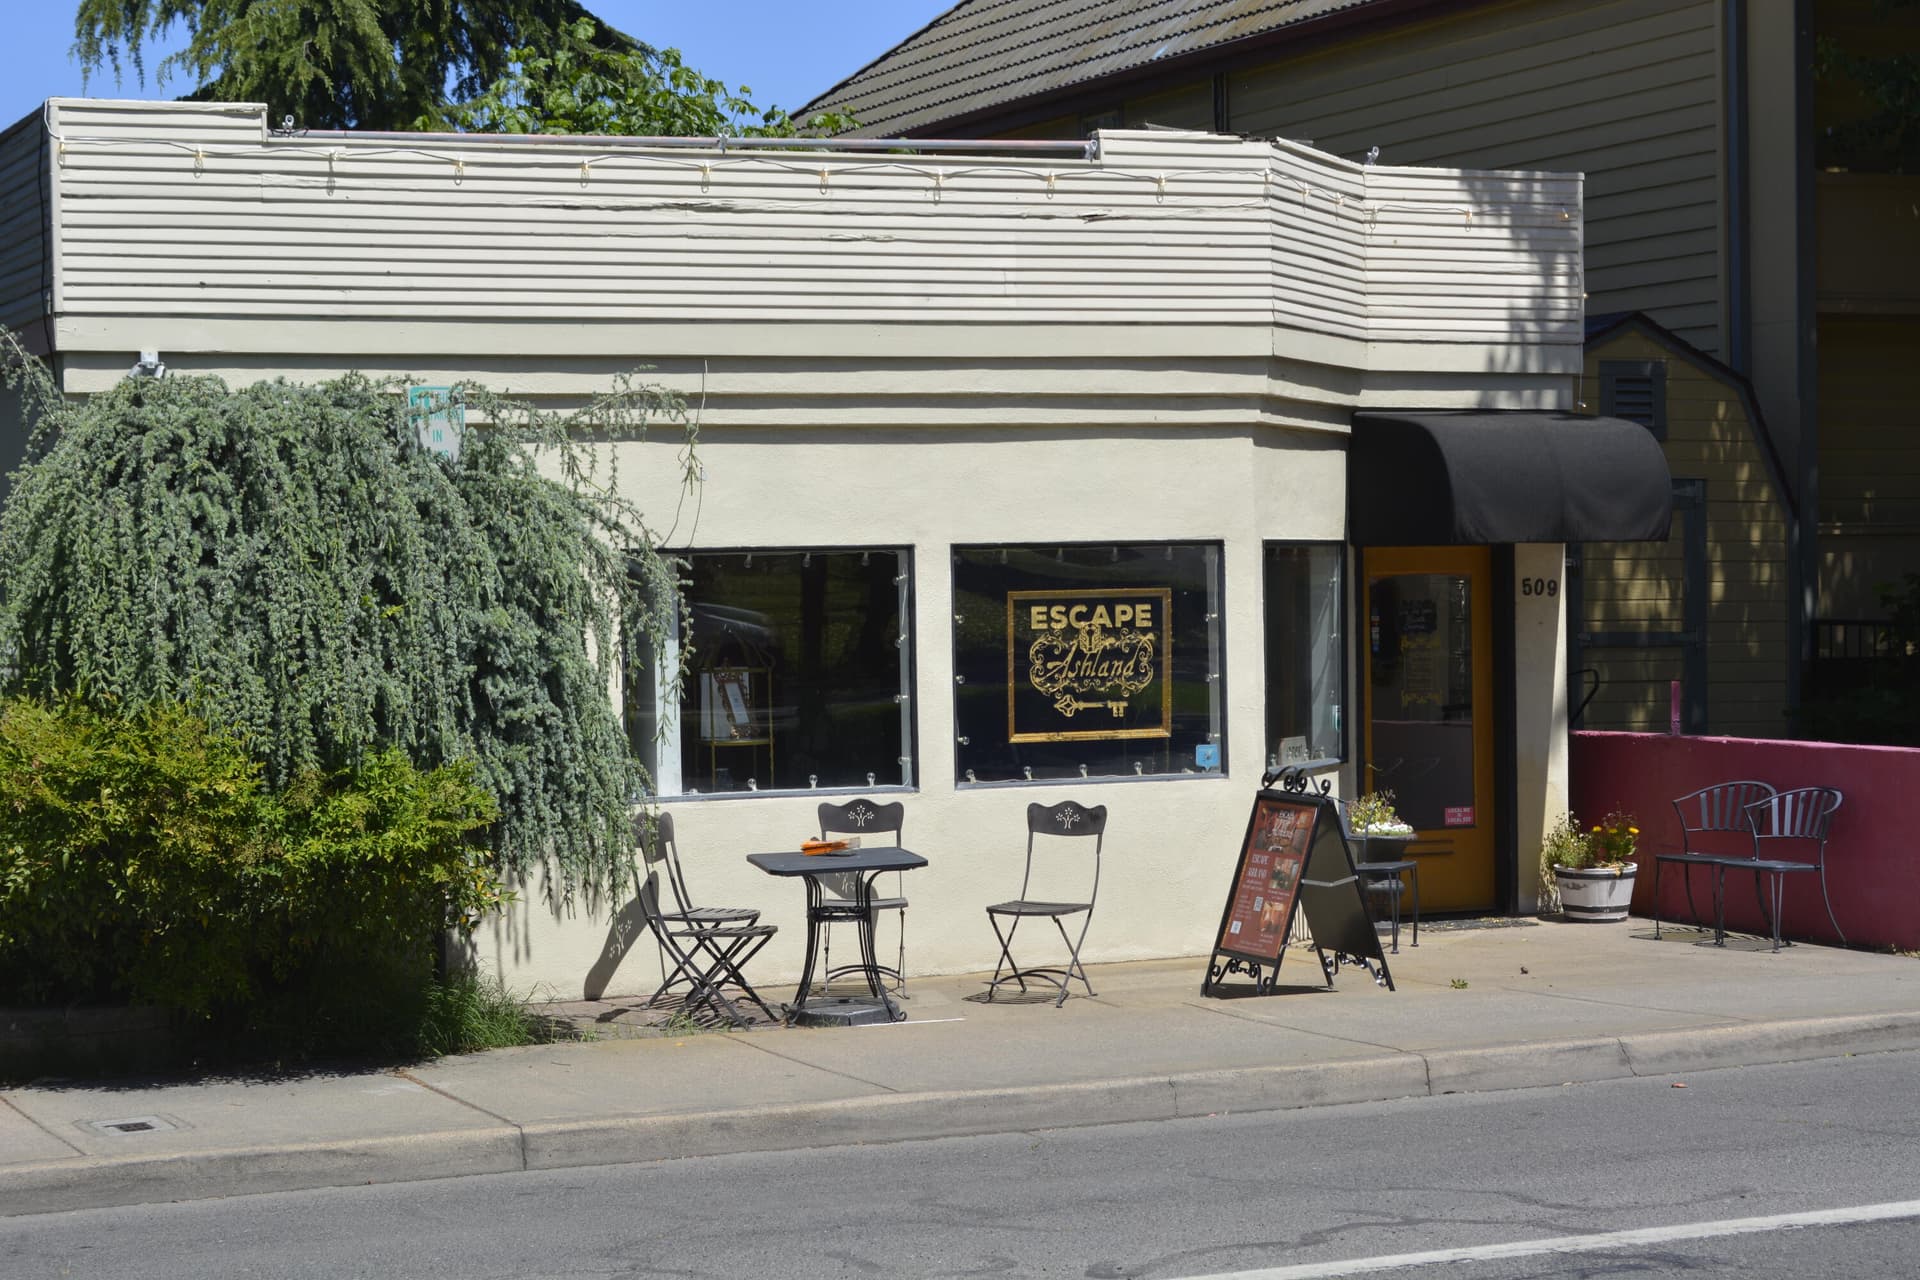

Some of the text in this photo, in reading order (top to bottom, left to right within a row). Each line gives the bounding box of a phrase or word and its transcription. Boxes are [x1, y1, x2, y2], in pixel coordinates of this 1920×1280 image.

[432, 429, 443, 443] IN
[1522, 577, 1558, 597] 509
[1030, 604, 1152, 630] ESCAPE
[1040, 632, 1155, 680] Ashland
